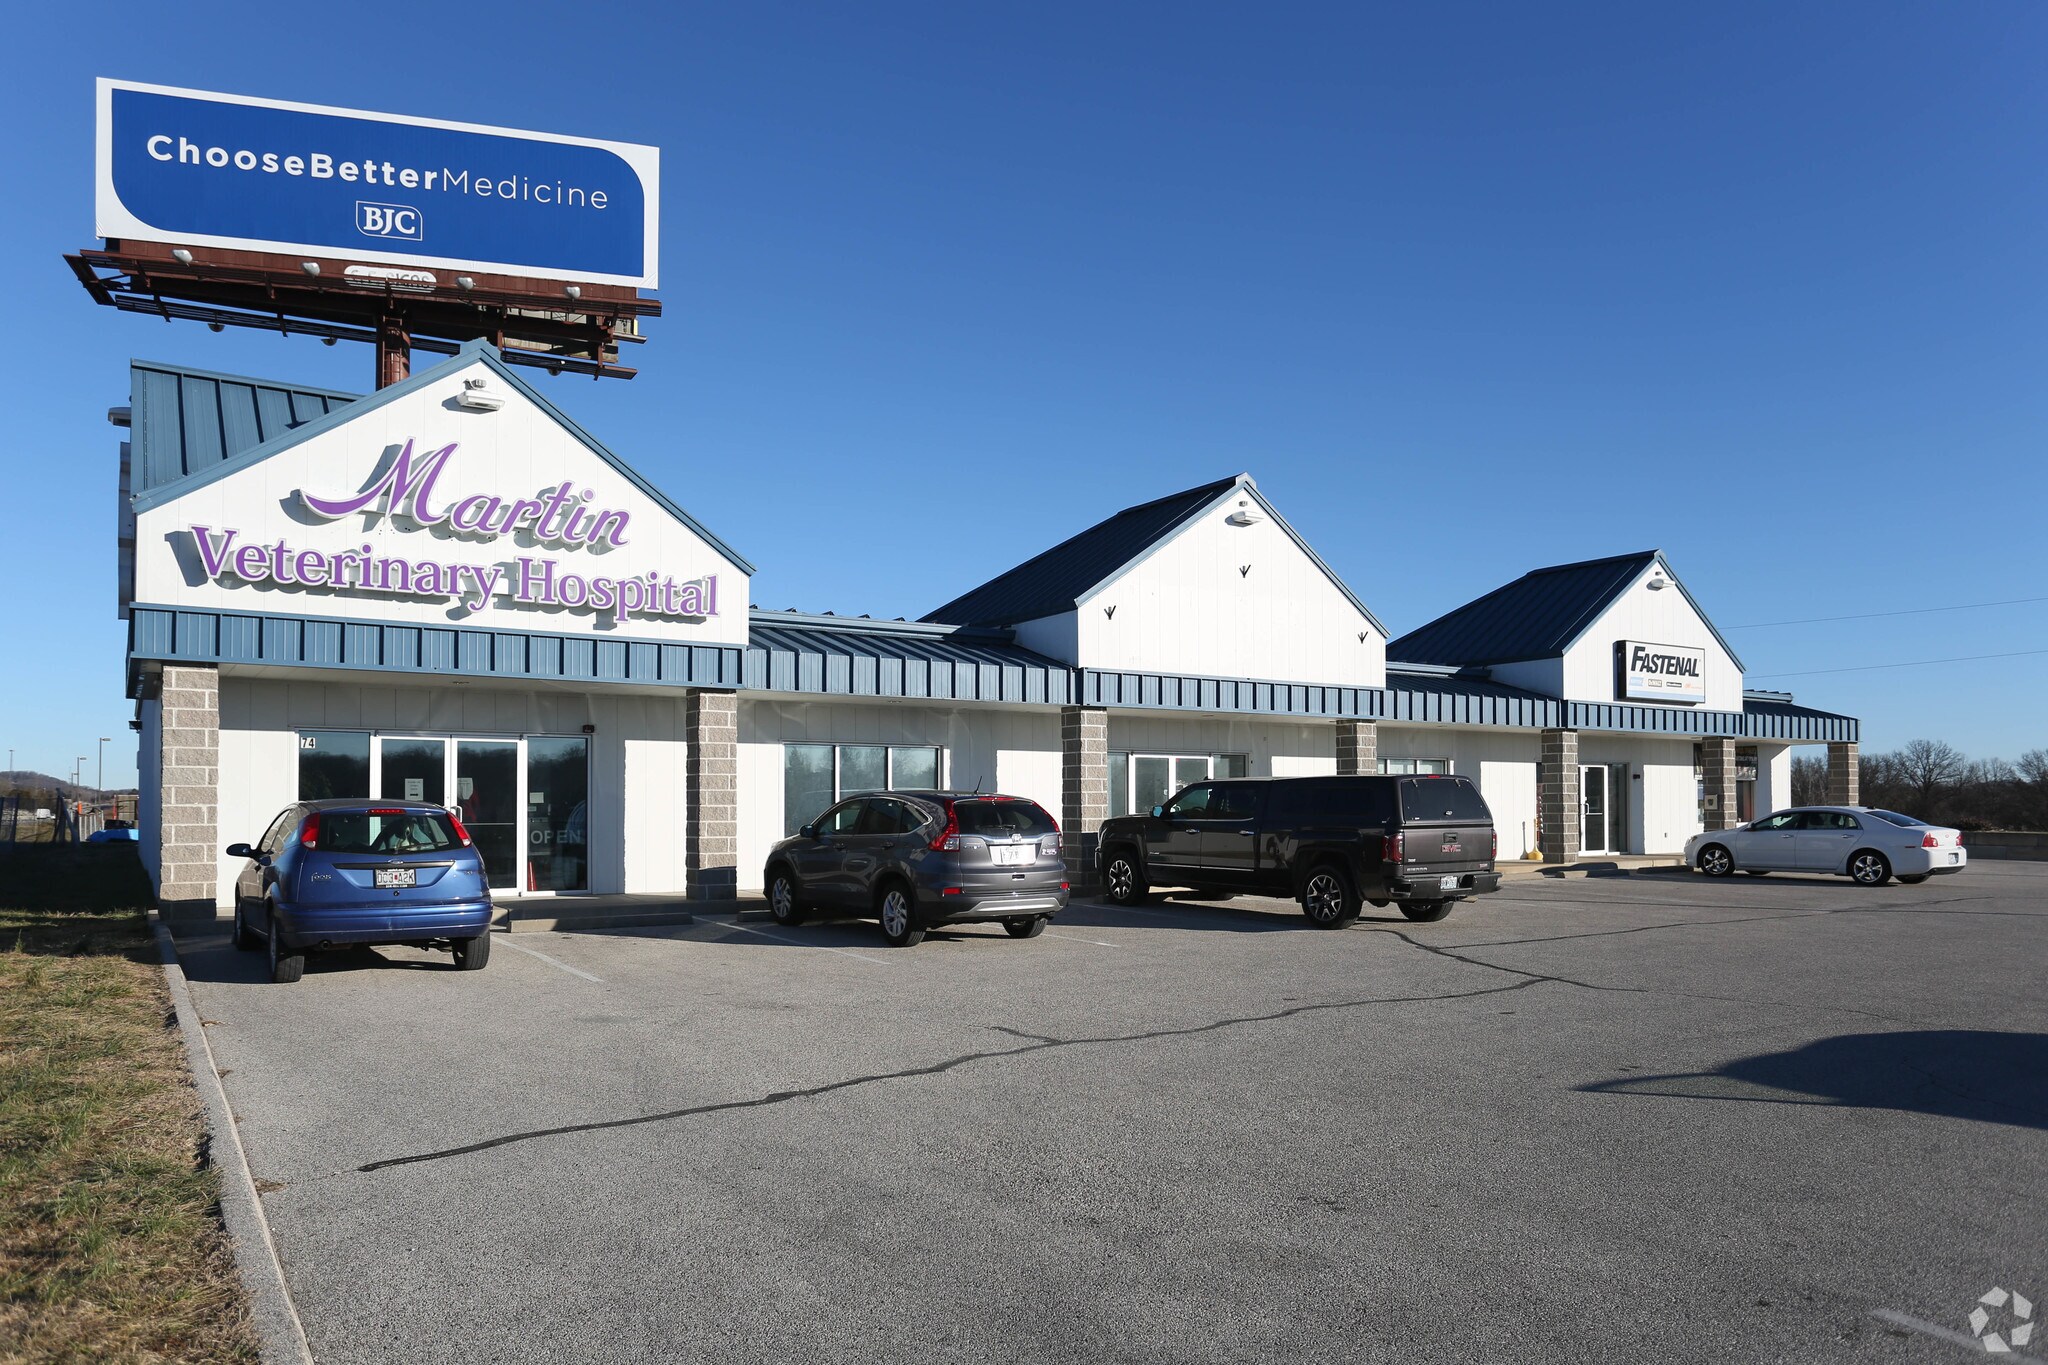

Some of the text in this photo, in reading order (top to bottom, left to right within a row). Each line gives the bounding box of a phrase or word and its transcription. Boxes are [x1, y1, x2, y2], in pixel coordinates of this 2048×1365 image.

[363, 206, 416, 235] BJC
[301, 437, 631, 547] Martin
[190, 525, 720, 623] Veterinary Hospital
[302, 737, 315, 748] 74
[530, 830, 581, 844] OPEN
